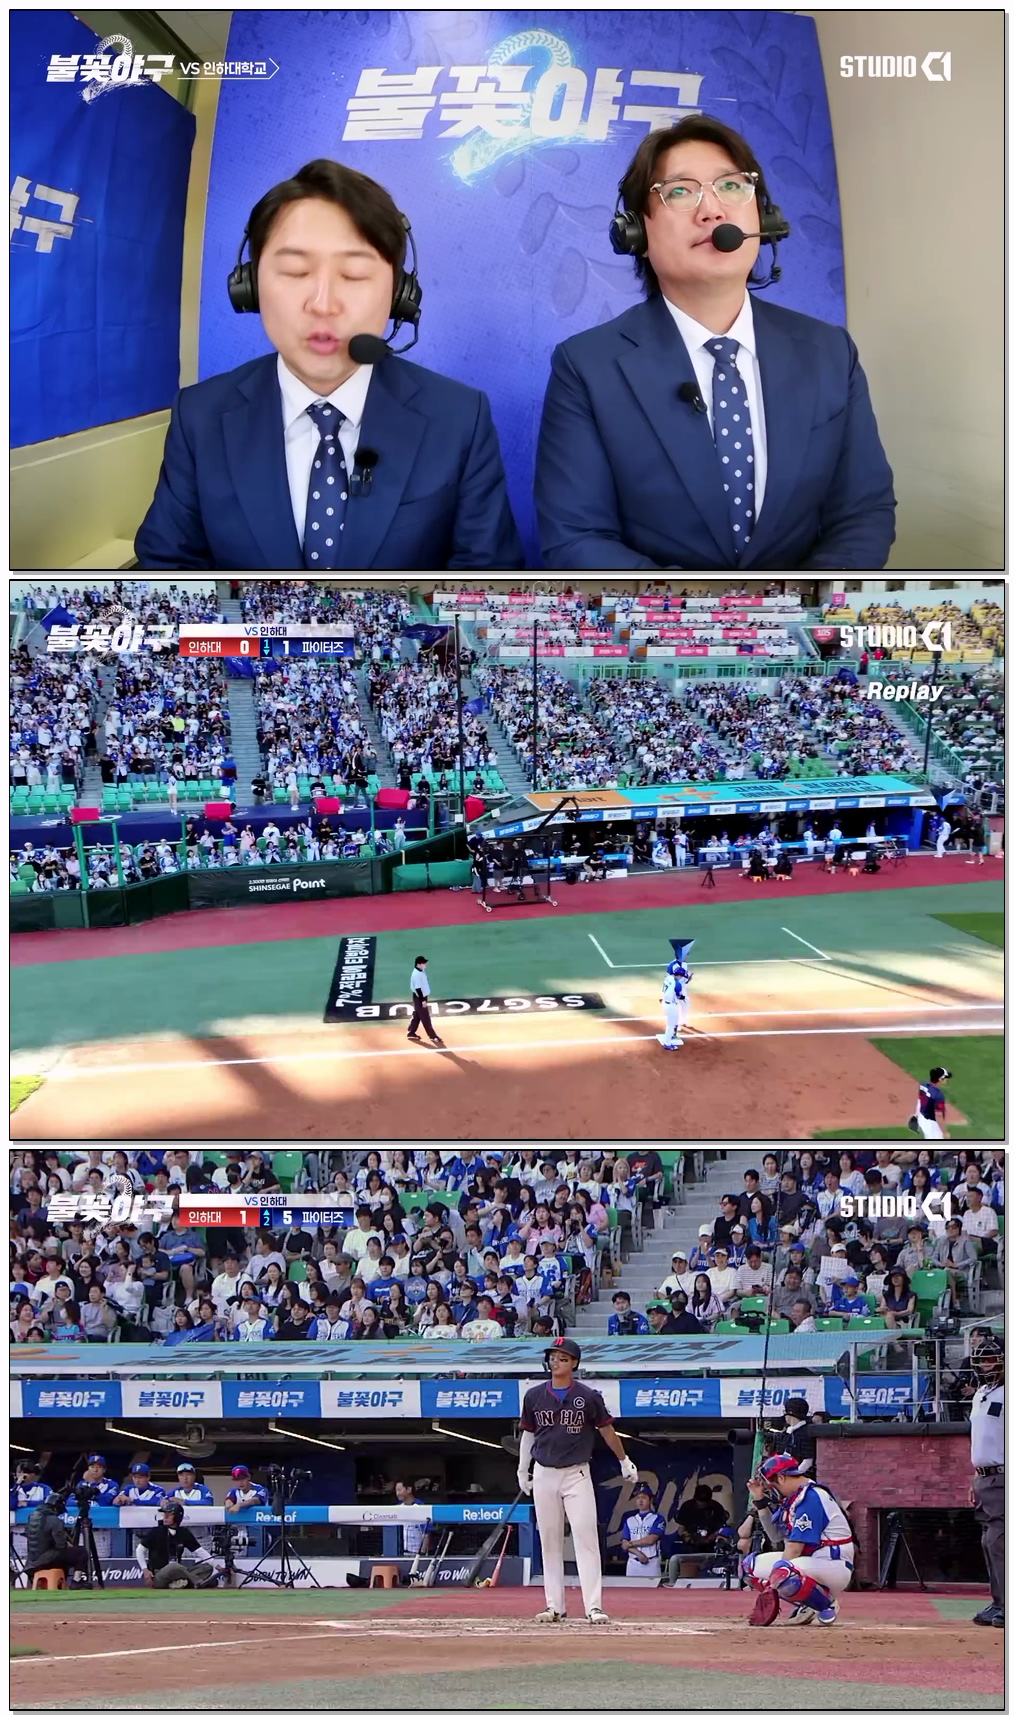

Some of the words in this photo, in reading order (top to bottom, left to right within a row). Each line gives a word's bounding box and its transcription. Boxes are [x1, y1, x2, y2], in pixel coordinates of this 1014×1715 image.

[249, 883, 291, 892] SHINSEGAE
[293, 877, 326, 892] Point
[335, 989, 363, 1007] 7%
[38, 1391, 106, 1408] 불꽃야구
[138, 1391, 205, 1408] 불꽃야구
[237, 1391, 304, 1408] 불꽃야구
[337, 1391, 403, 1408] 불꽃야구
[436, 1391, 503, 1408] 불꽃야구
[635, 1388, 704, 1407] 불꽃야구
[463, 1509, 503, 1521] Re:leaf
[122, 1567, 144, 1580] WIN
